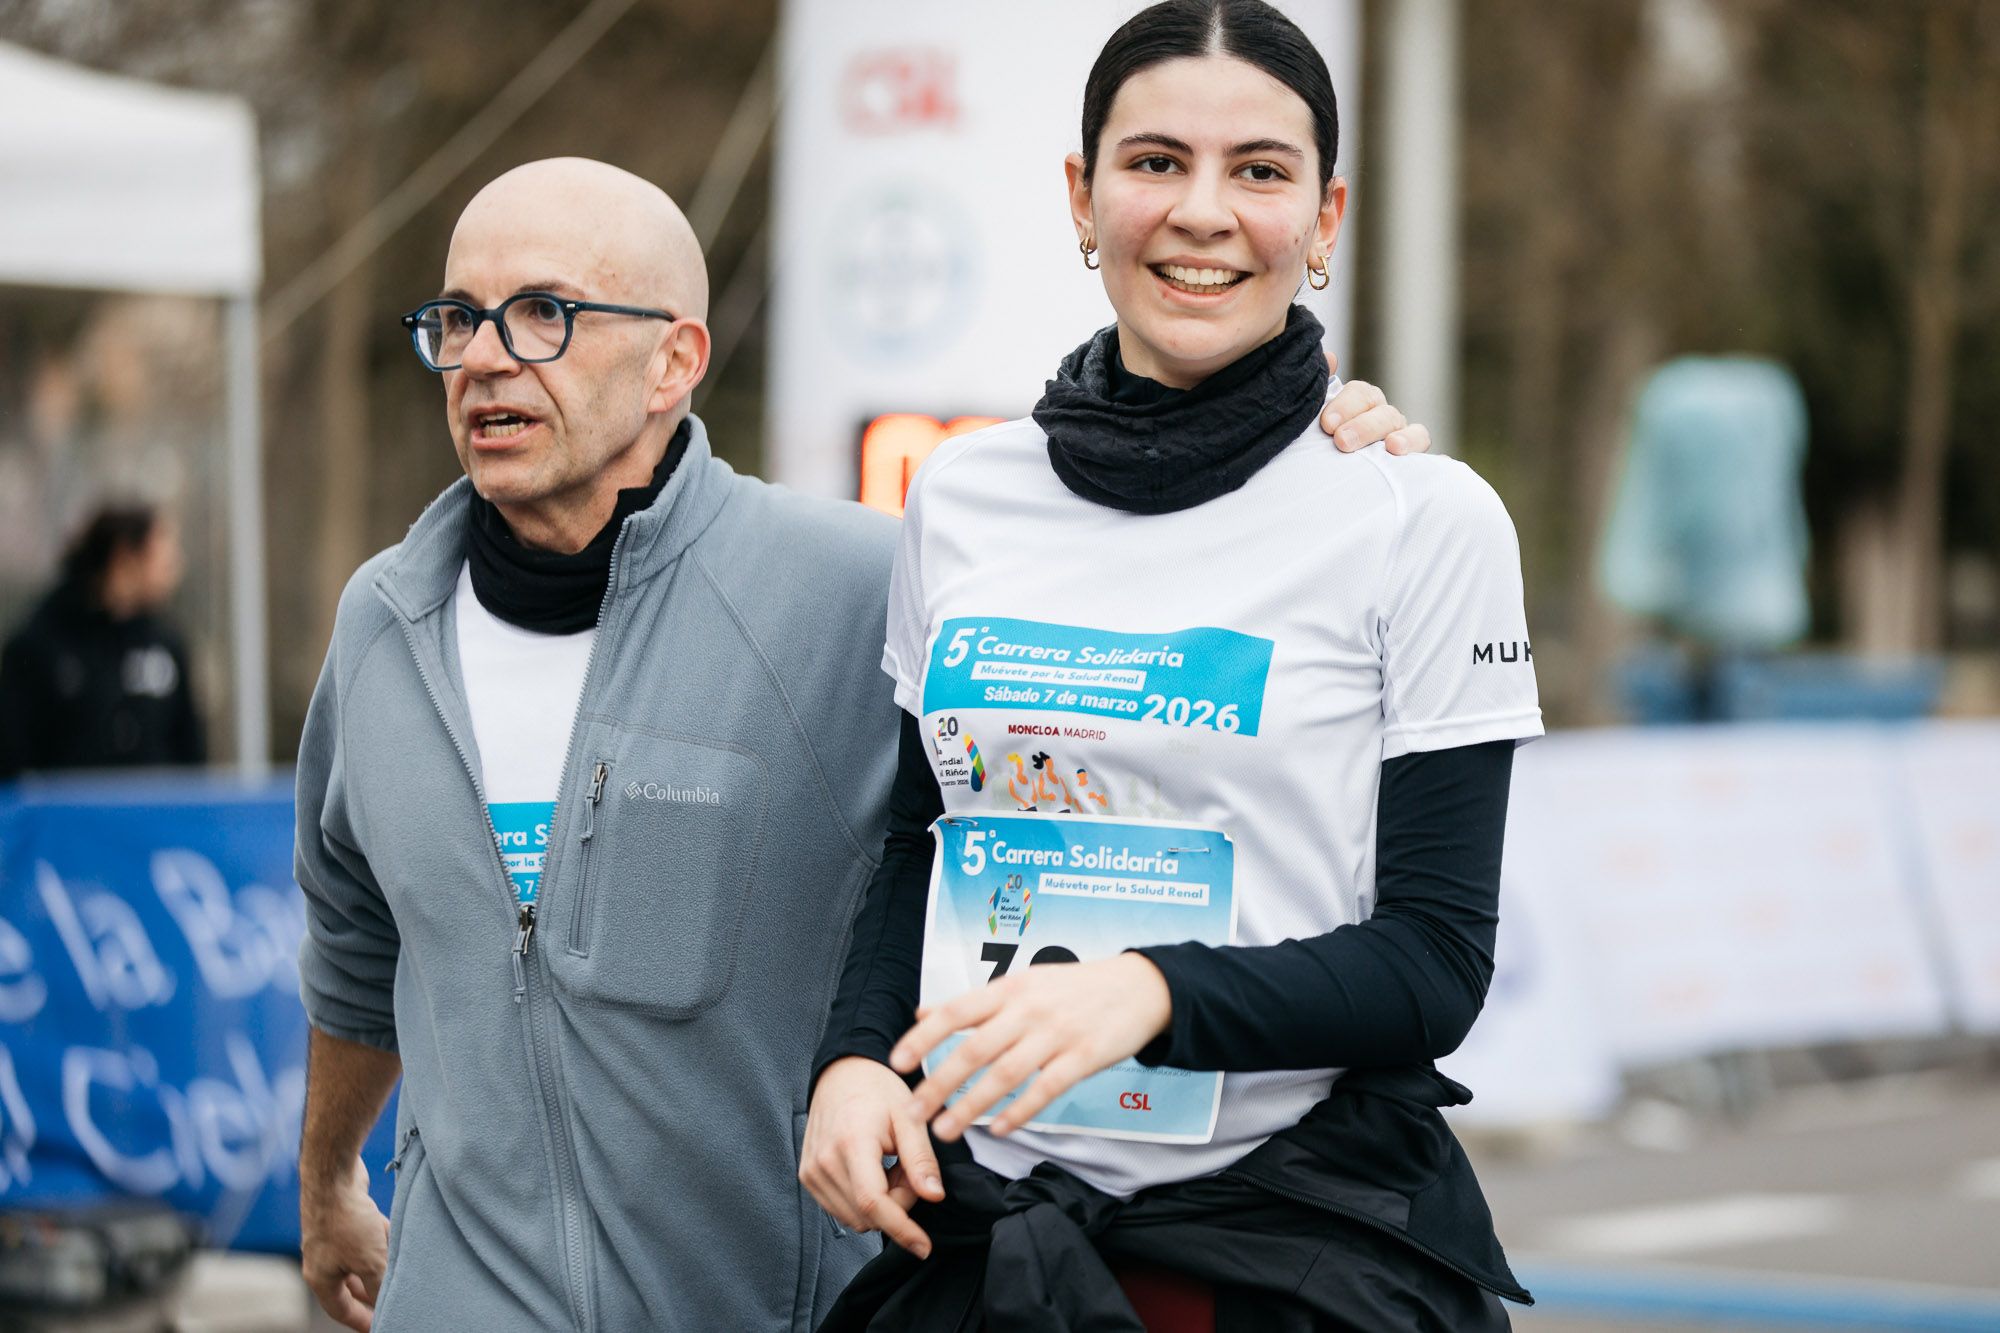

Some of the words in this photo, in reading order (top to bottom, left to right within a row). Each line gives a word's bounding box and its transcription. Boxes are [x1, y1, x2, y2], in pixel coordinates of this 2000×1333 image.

[977, 636, 1071, 662] Carrera
[1075, 645, 1184, 668] Solidaria
[980, 664, 1028, 676] Muévete
[1030, 670, 1050, 680] por
[1053, 668, 1065, 680] la
[1068, 671, 1101, 682] Salud
[1103, 673, 1139, 685] Renal
[984, 686, 1040, 703] Sábado
[1042, 689, 1055, 703] 7
[1056, 690, 1079, 706] de
[1080, 695, 1139, 713] marzo
[1141, 693, 1241, 734] 2026
[1008, 724, 1060, 737] MONCLOA
[1063, 727, 1107, 741] MADRID
[643, 782, 720, 805] Columbia
[524, 857, 535, 867] la
[991, 840, 1064, 867] Carrera
[1069, 844, 1179, 875] Solidaria
[1045, 878, 1089, 890] Muévete
[1092, 883, 1112, 894] por
[1116, 882, 1126, 893] la
[1130, 884, 1164, 896] Salud
[1167, 886, 1203, 899] Renal
[1119, 1091, 1152, 1112] CSL
